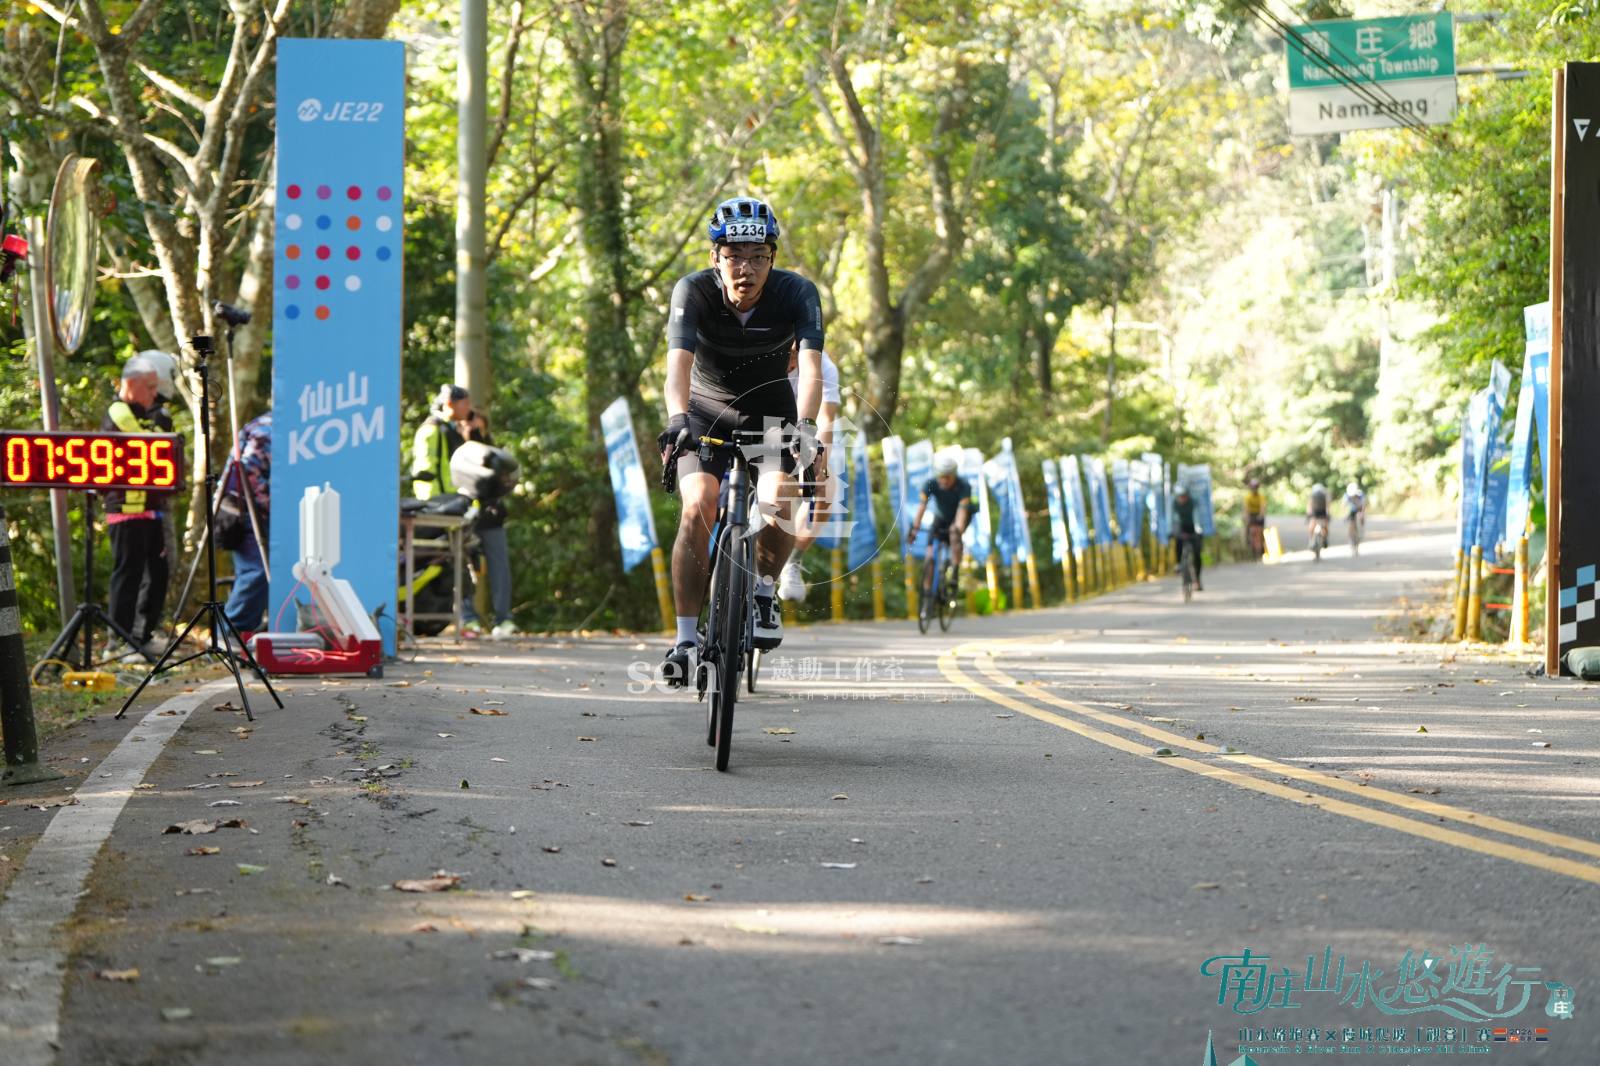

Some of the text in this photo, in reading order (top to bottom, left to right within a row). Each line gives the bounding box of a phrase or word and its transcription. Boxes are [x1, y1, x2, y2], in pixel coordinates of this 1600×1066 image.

[1379, 55, 1439, 75] Township
[323, 101, 385, 122] JE22
[299, 371, 369, 422] 仙山
[288, 405, 385, 465] KOM
[7, 437, 176, 487] 07:59:35
